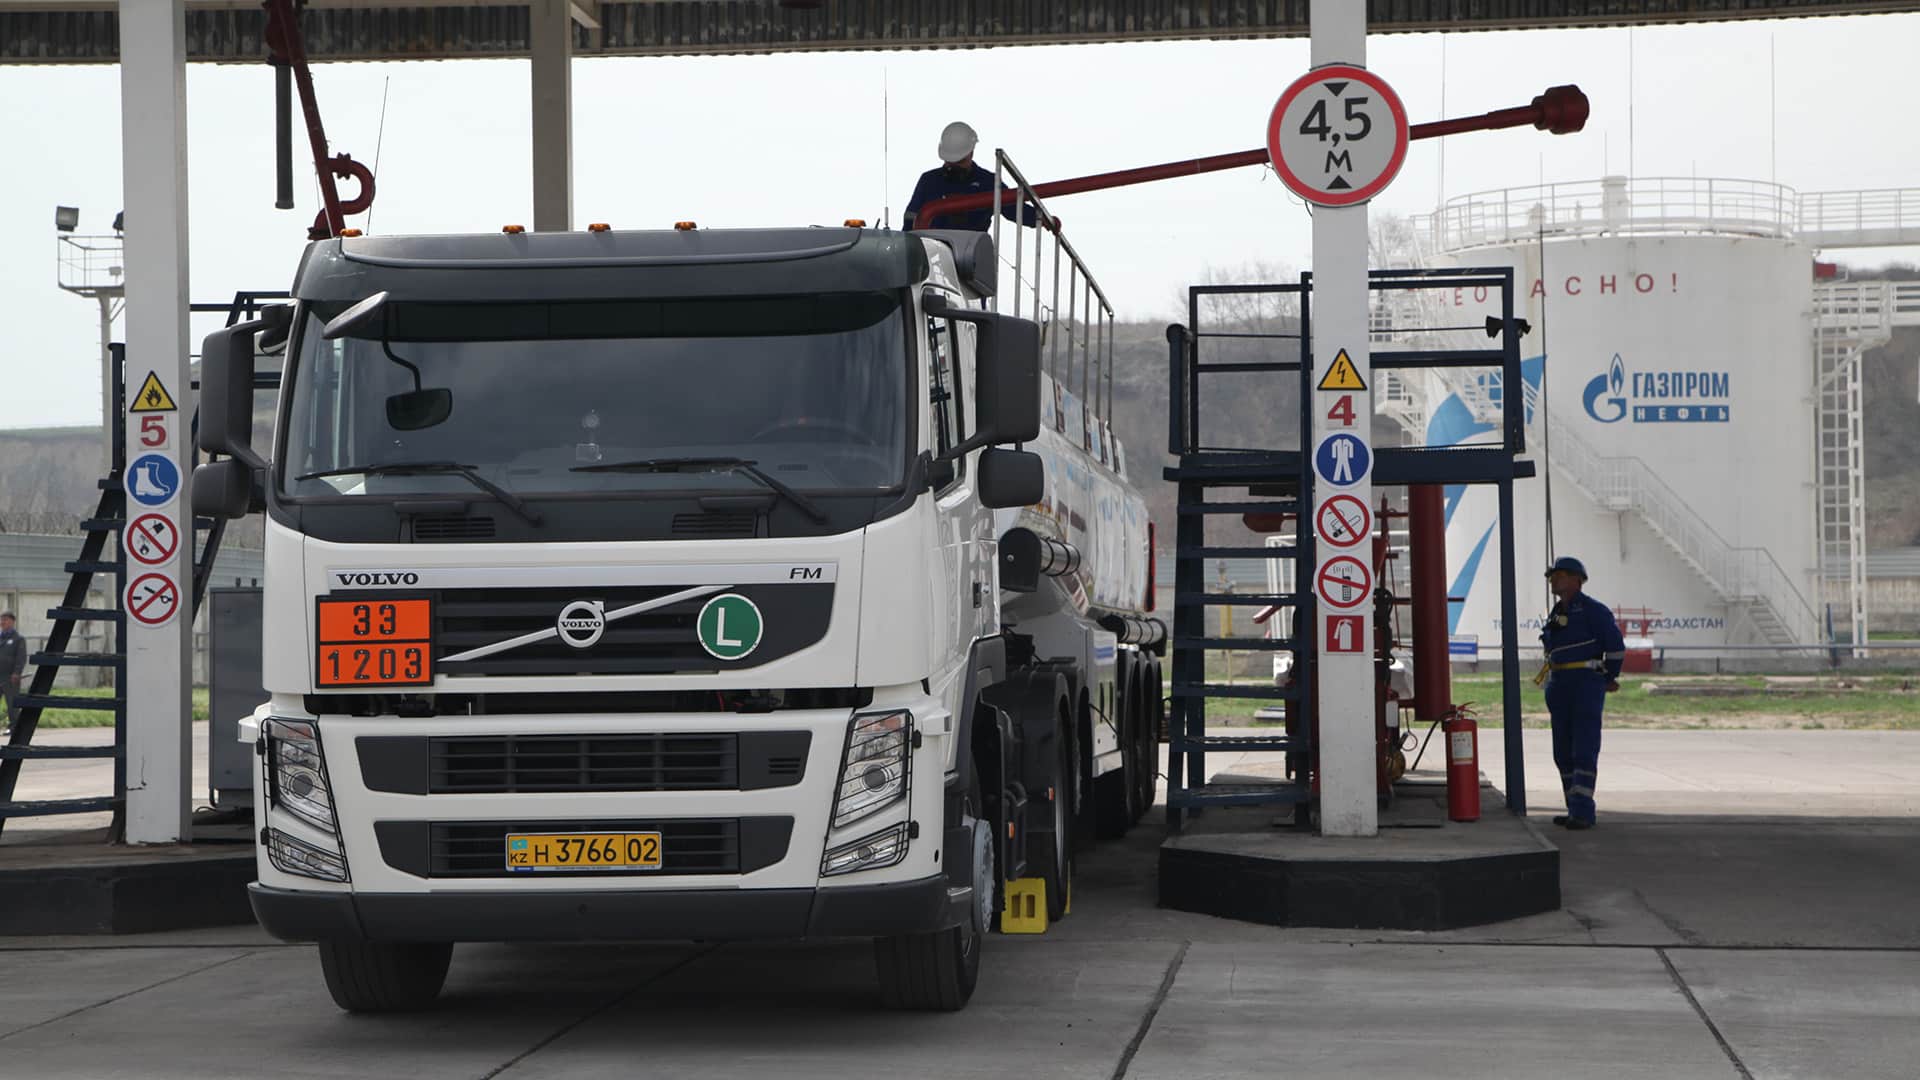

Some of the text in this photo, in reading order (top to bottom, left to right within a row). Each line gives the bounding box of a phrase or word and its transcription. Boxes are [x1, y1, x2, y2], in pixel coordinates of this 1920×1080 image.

[1300, 97, 1371, 147] 4,5
[1632, 372, 1729, 398] ГАЗПРОМ
[1327, 395, 1356, 426] 4
[1636, 406, 1728, 421] НЕФТЬ
[141, 415, 166, 447] 5
[336, 573, 419, 586] VOLVO
[789, 567, 822, 579] FM
[353, 604, 396, 635] 33
[560, 620, 601, 628] VOLVO
[716, 607, 742, 647] L
[328, 648, 421, 680] 1203
[510, 838, 658, 863] KZ H 3766 02
